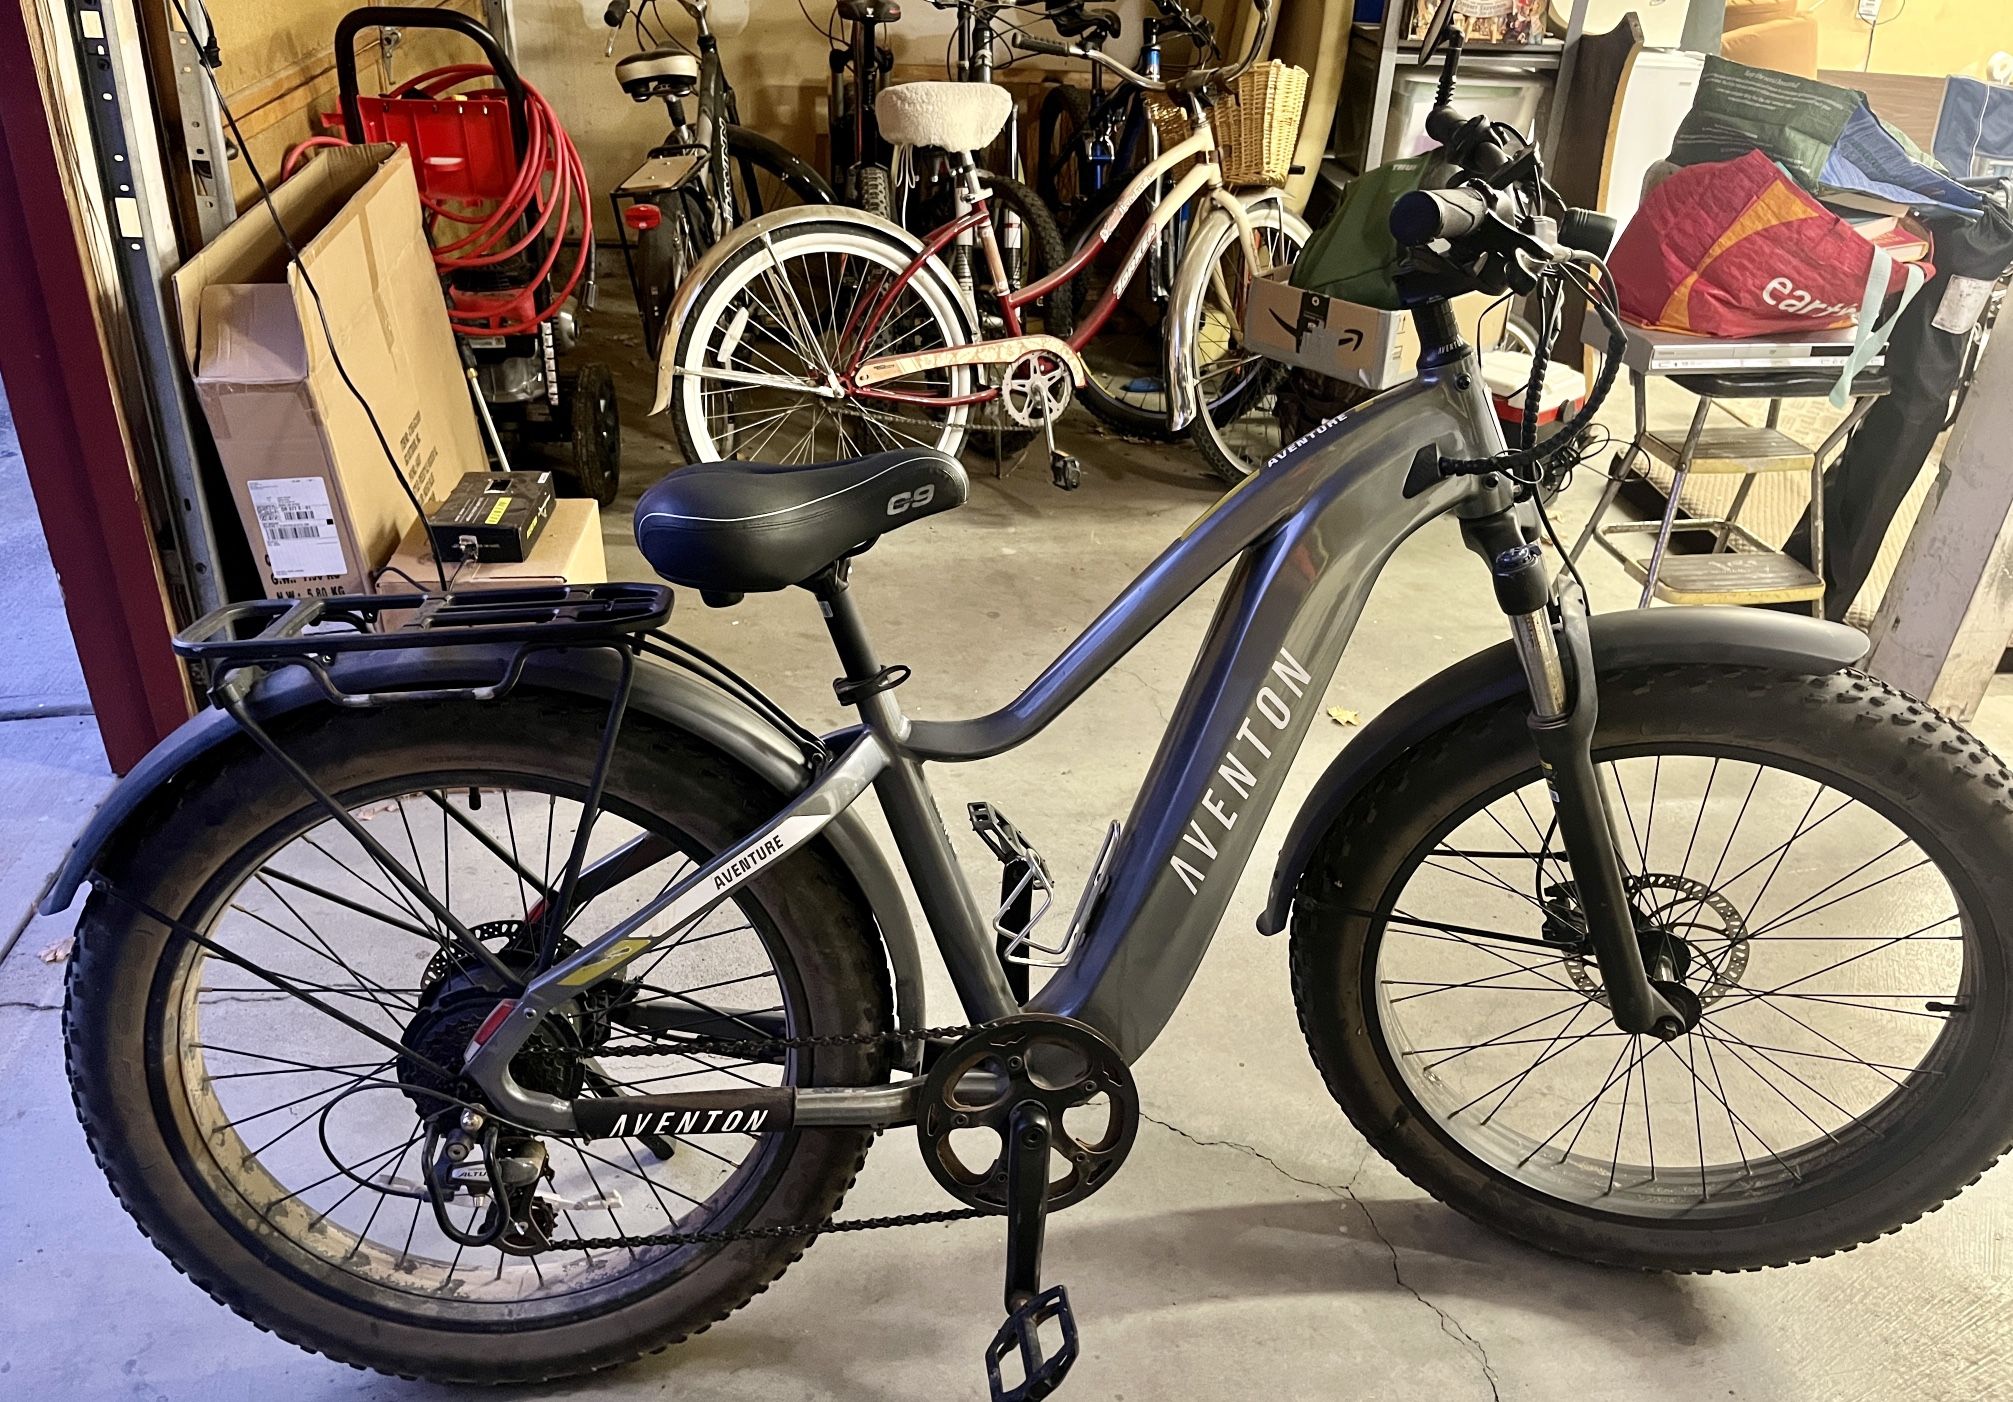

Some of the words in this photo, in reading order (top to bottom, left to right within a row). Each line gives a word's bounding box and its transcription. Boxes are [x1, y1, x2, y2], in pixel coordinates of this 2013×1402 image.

[1267, 413, 1348, 468] AVENTURE
[887, 484, 935, 515] C9
[331, 585, 346, 596] KG
[1170, 646, 1312, 896] AVENTON
[713, 834, 784, 890] AVENTURE
[609, 1109, 769, 1138] AVENTON
